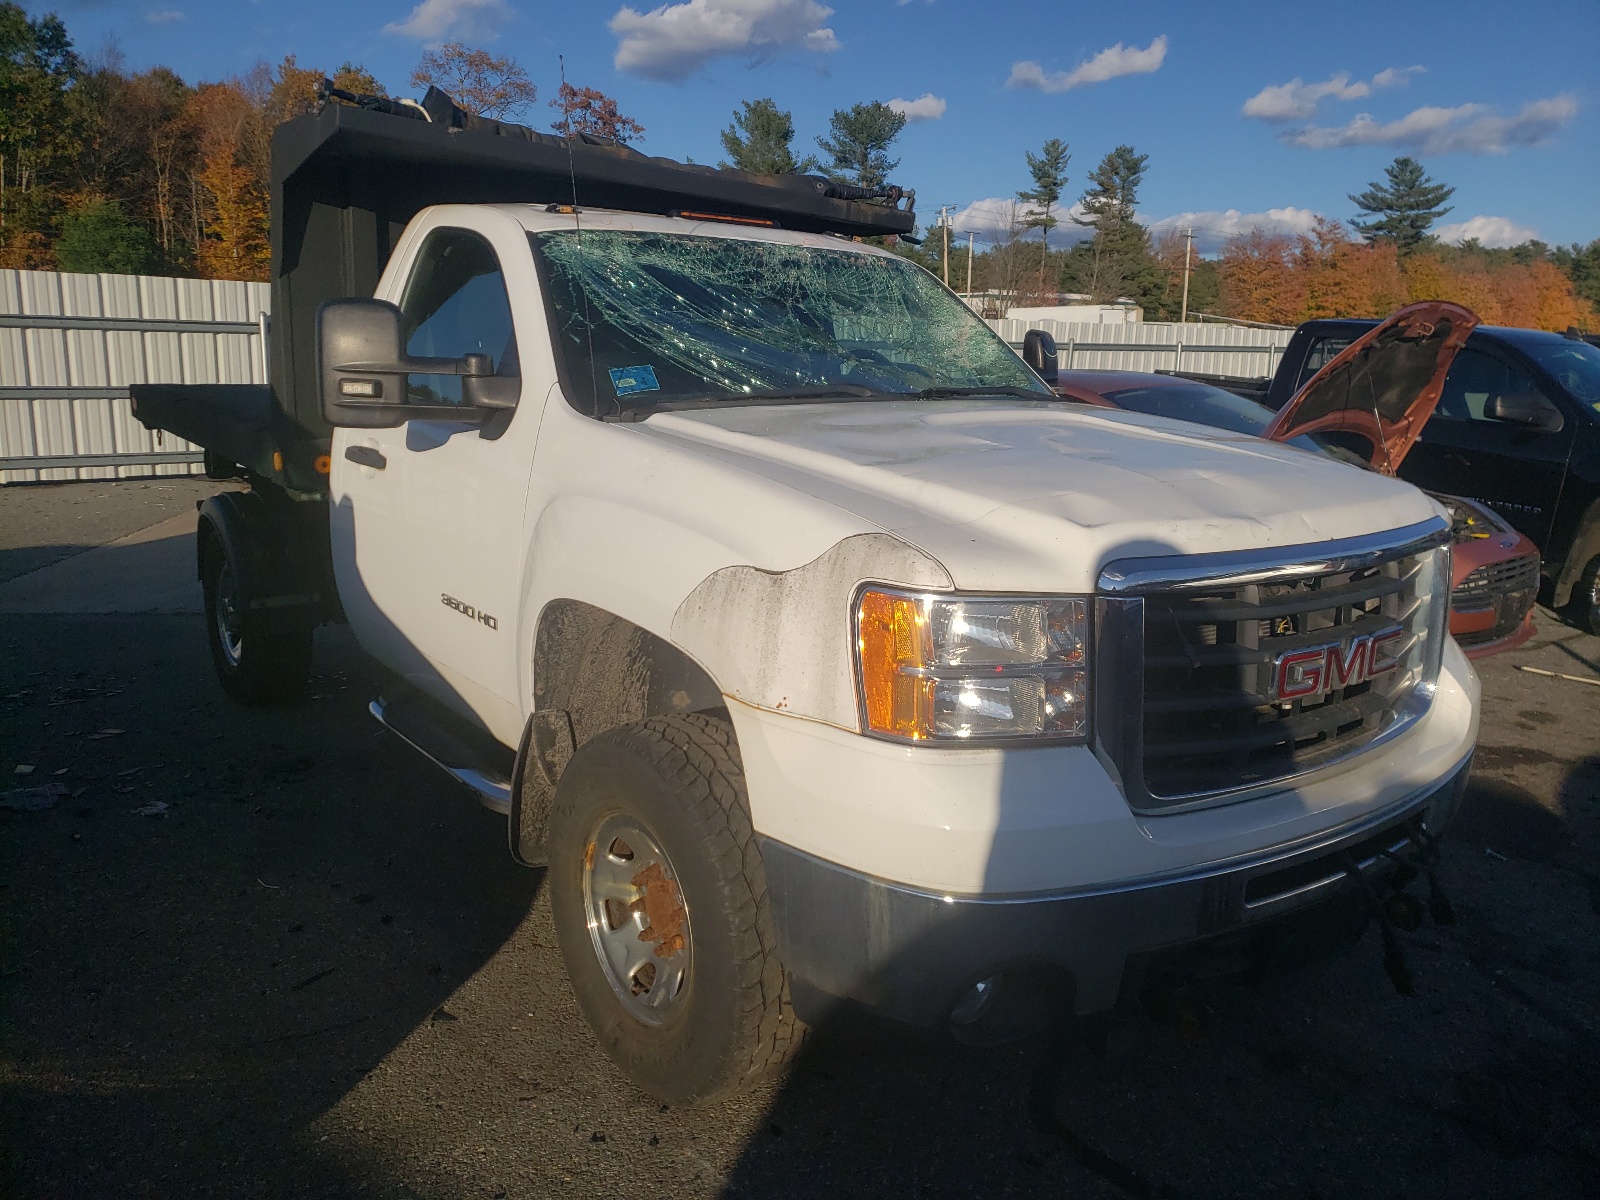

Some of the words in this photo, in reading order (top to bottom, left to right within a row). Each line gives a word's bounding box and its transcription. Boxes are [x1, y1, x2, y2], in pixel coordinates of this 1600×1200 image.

[441, 592, 475, 620] 3500
[477, 610, 499, 631] HD
[1271, 625, 1404, 700] GMC
